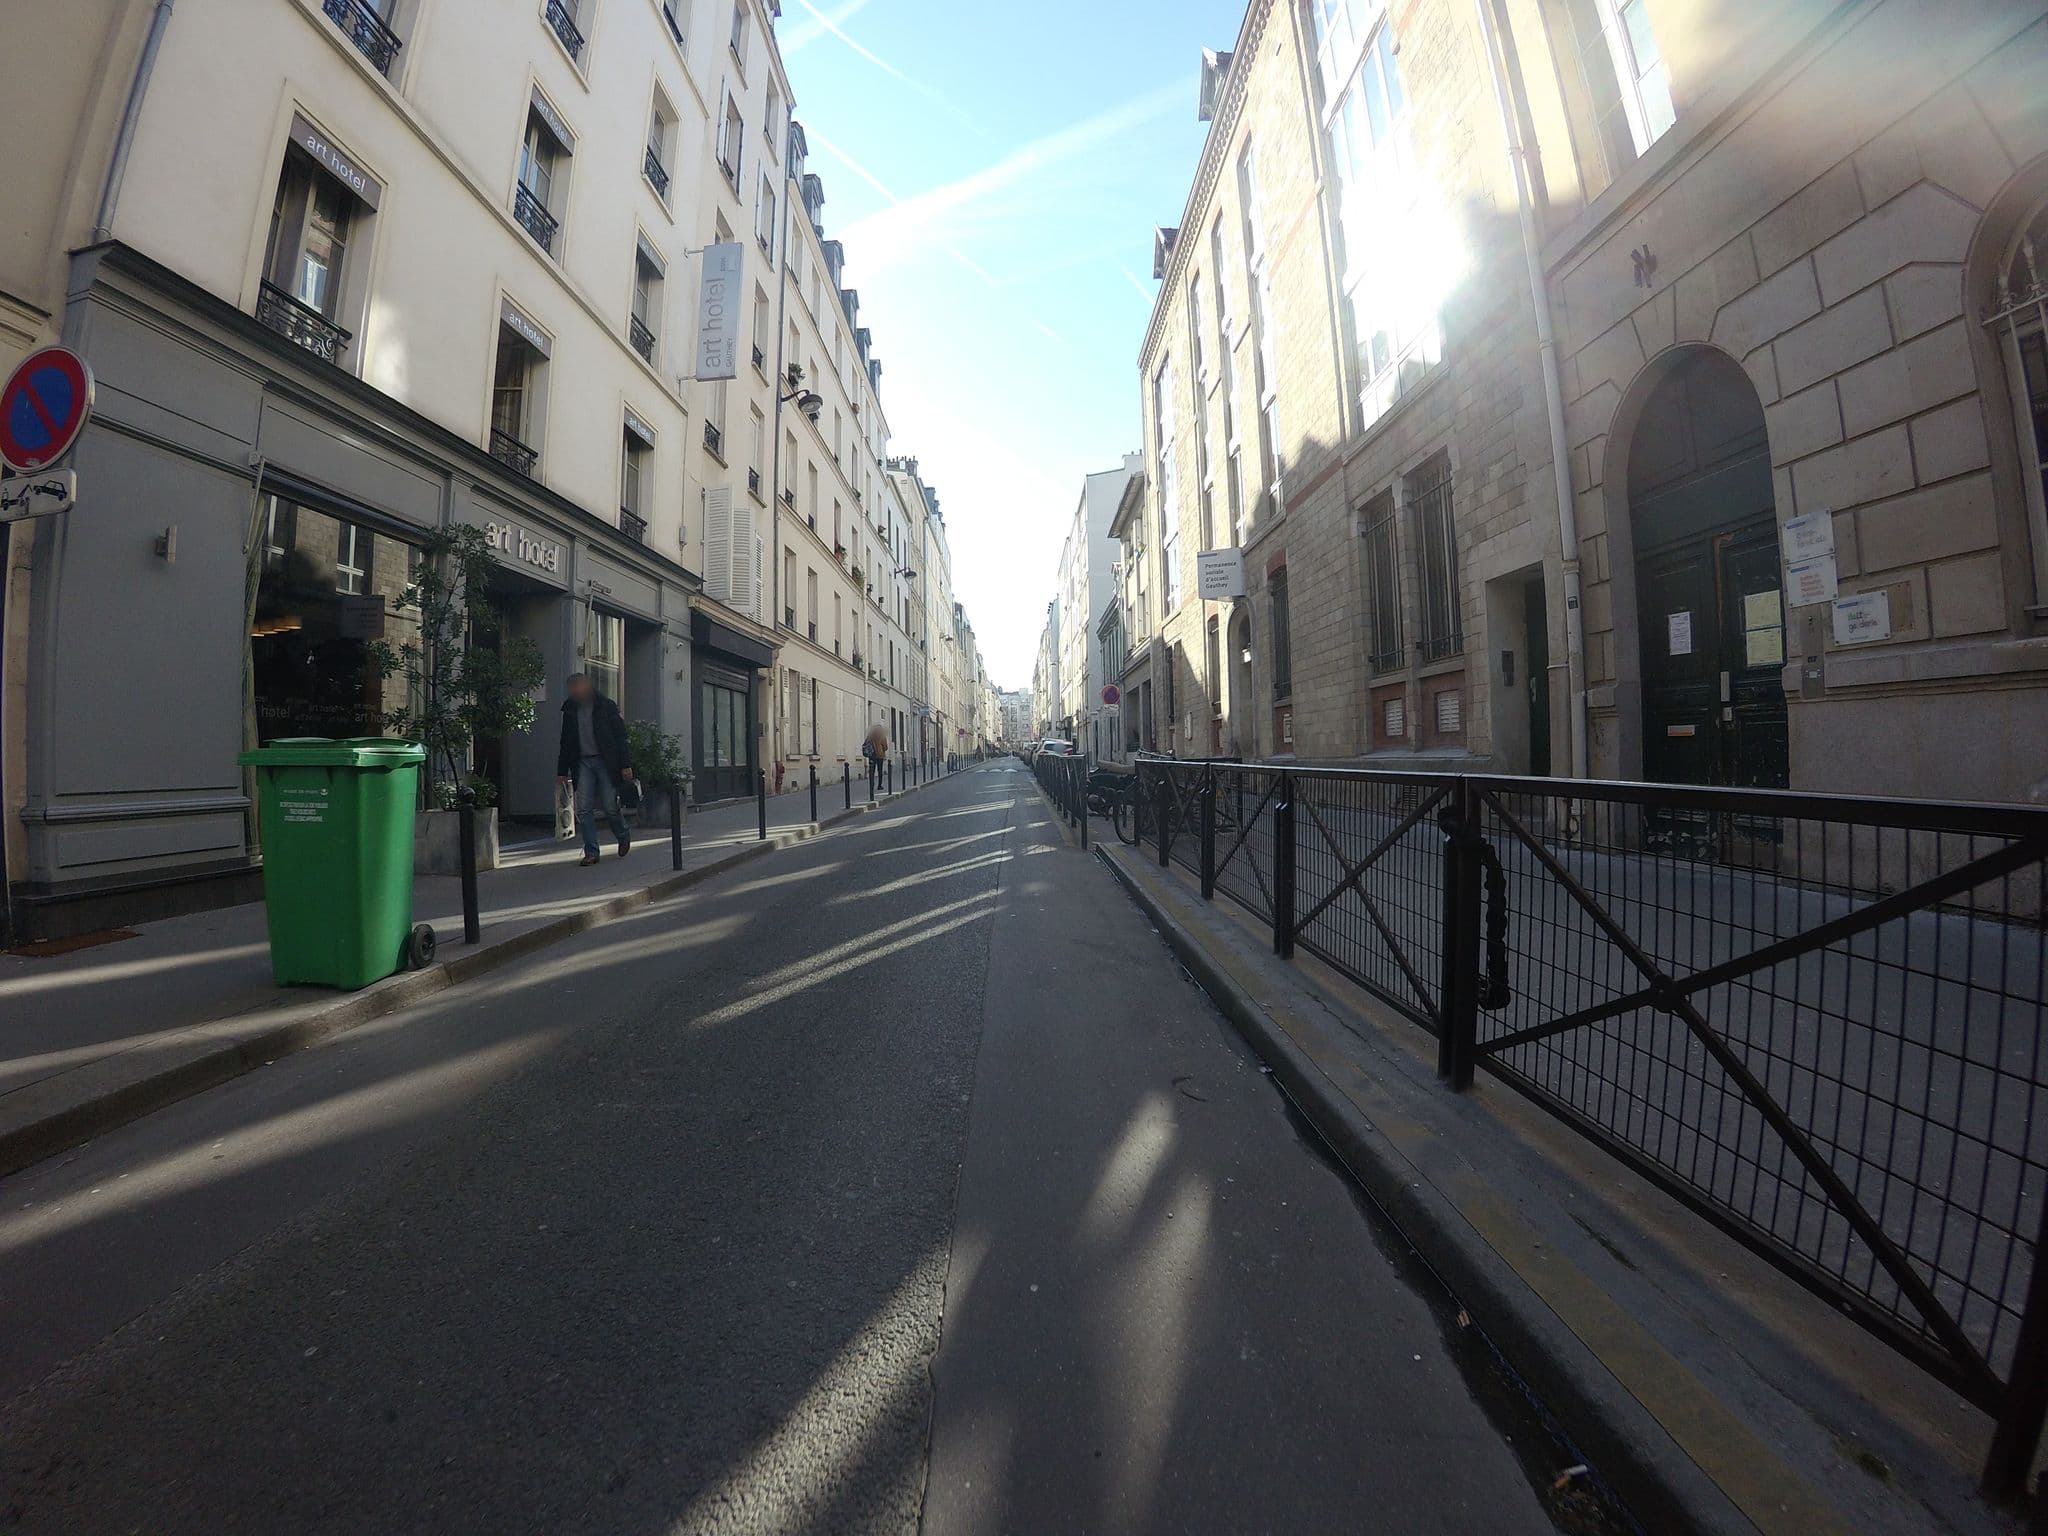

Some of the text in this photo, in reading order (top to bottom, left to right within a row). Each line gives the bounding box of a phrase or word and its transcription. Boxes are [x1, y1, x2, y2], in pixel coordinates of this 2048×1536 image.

[538, 100, 568, 142] art hotel
[307, 136, 366, 193] art hotel
[510, 313, 544, 348] art hotel
[702, 278, 725, 368] art hotel
[485, 522, 560, 573] art hotel
